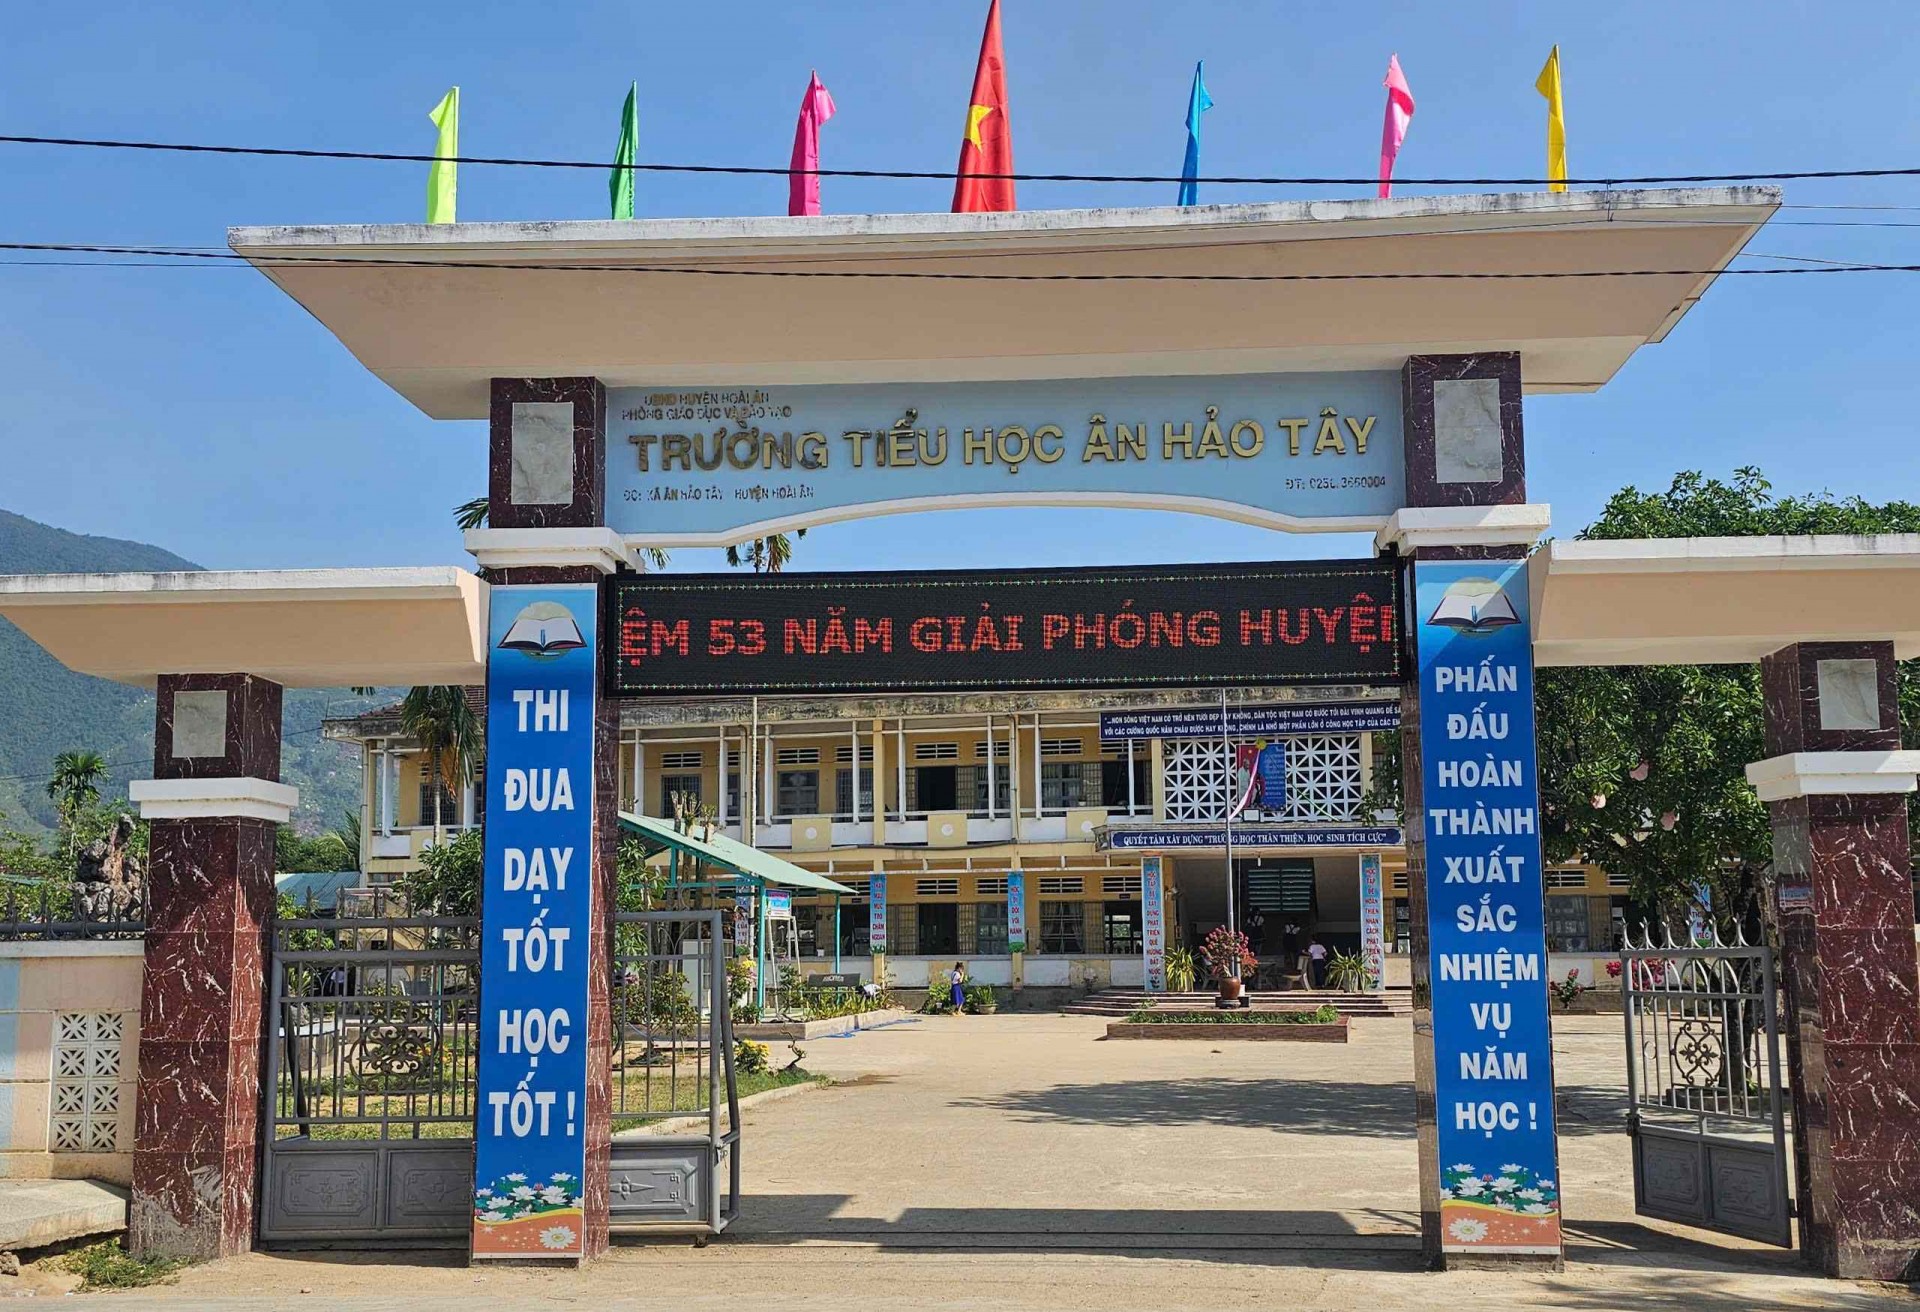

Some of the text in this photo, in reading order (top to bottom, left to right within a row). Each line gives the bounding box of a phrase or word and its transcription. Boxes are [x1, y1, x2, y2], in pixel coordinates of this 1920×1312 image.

[628, 406, 1377, 473] TRƯỜNG TIỂU HỌC ÂN HẢO TÂY
[707, 618, 767, 656] 53
[783, 605, 893, 655] NĂM
[909, 601, 1024, 653] GIẢI
[1043, 598, 1222, 650] PHÓNG
[1435, 654, 1518, 693] PHẤN
[512, 689, 569, 733] THI
[1104, 726, 1114, 736] VỚI
[1114, 726, 1126, 736] CÁC
[1126, 725, 1144, 734] CƯỜNG
[1146, 724, 1160, 734] QUỐC
[1174, 724, 1189, 734] CHÂU
[1190, 724, 1204, 734] ĐƯỢC
[1205, 724, 1216, 732] HAY
[1258, 721, 1265, 730] LÀ
[1266, 720, 1278, 730] NHỜ
[1278, 720, 1290, 732] MỘT
[1308, 720, 1319, 729] LỚN
[1326, 718, 1340, 728] CÔNG
[1342, 720, 1354, 730] HỌC
[1354, 718, 1366, 728] TẬP
[1366, 717, 1378, 726] CỦA
[1380, 717, 1392, 726] CÁC
[1124, 714, 1138, 724] SÔNG
[1138, 714, 1150, 724] VIỆT
[1164, 714, 1172, 722] CÓ
[1172, 712, 1182, 722] TRỞ
[1184, 712, 1195, 722] NÊN
[1196, 712, 1208, 721] TƯƠI
[1208, 713, 1220, 722] ĐẸP
[1254, 710, 1266, 719] DÂN
[1266, 710, 1278, 720] TỘC
[1278, 710, 1290, 720] VIỆT
[1291, 710, 1304, 718] NAM
[1304, 708, 1313, 718] CÓ
[1314, 708, 1328, 717] BƯỚC
[1350, 708, 1364, 716] VINH
[1365, 707, 1384, 715] QUANG
[1446, 701, 1509, 740] ĐẤU
[1438, 752, 1523, 787] HOÀN
[504, 768, 575, 812] ĐUA
[1429, 800, 1535, 836] THÀNH
[1124, 833, 1148, 846] QUYẾT
[1149, 834, 1165, 845] TÂM
[1166, 834, 1181, 845] XÂY
[1182, 834, 1204, 846] DỰNG
[1240, 834, 1256, 845] HỌC
[1256, 834, 1278, 844] THÂN
[1280, 832, 1306, 844] THIỆN,
[1307, 833, 1324, 844] HỌC
[1326, 833, 1345, 842] SINH
[1346, 831, 1366, 842] TÍCH
[503, 847, 574, 905] DẠY
[1444, 844, 1525, 884] XUẤT
[1456, 892, 1518, 933] SẮC
[502, 908, 571, 973] TỐT
[1439, 947, 1539, 989] NHIỆM
[498, 1007, 571, 1068] HỌC
[1470, 1003, 1512, 1038] VỤ
[1459, 1045, 1528, 1080] NĂM
[488, 1071, 556, 1138] TỐT
[1455, 1101, 1520, 1138] HỌC
